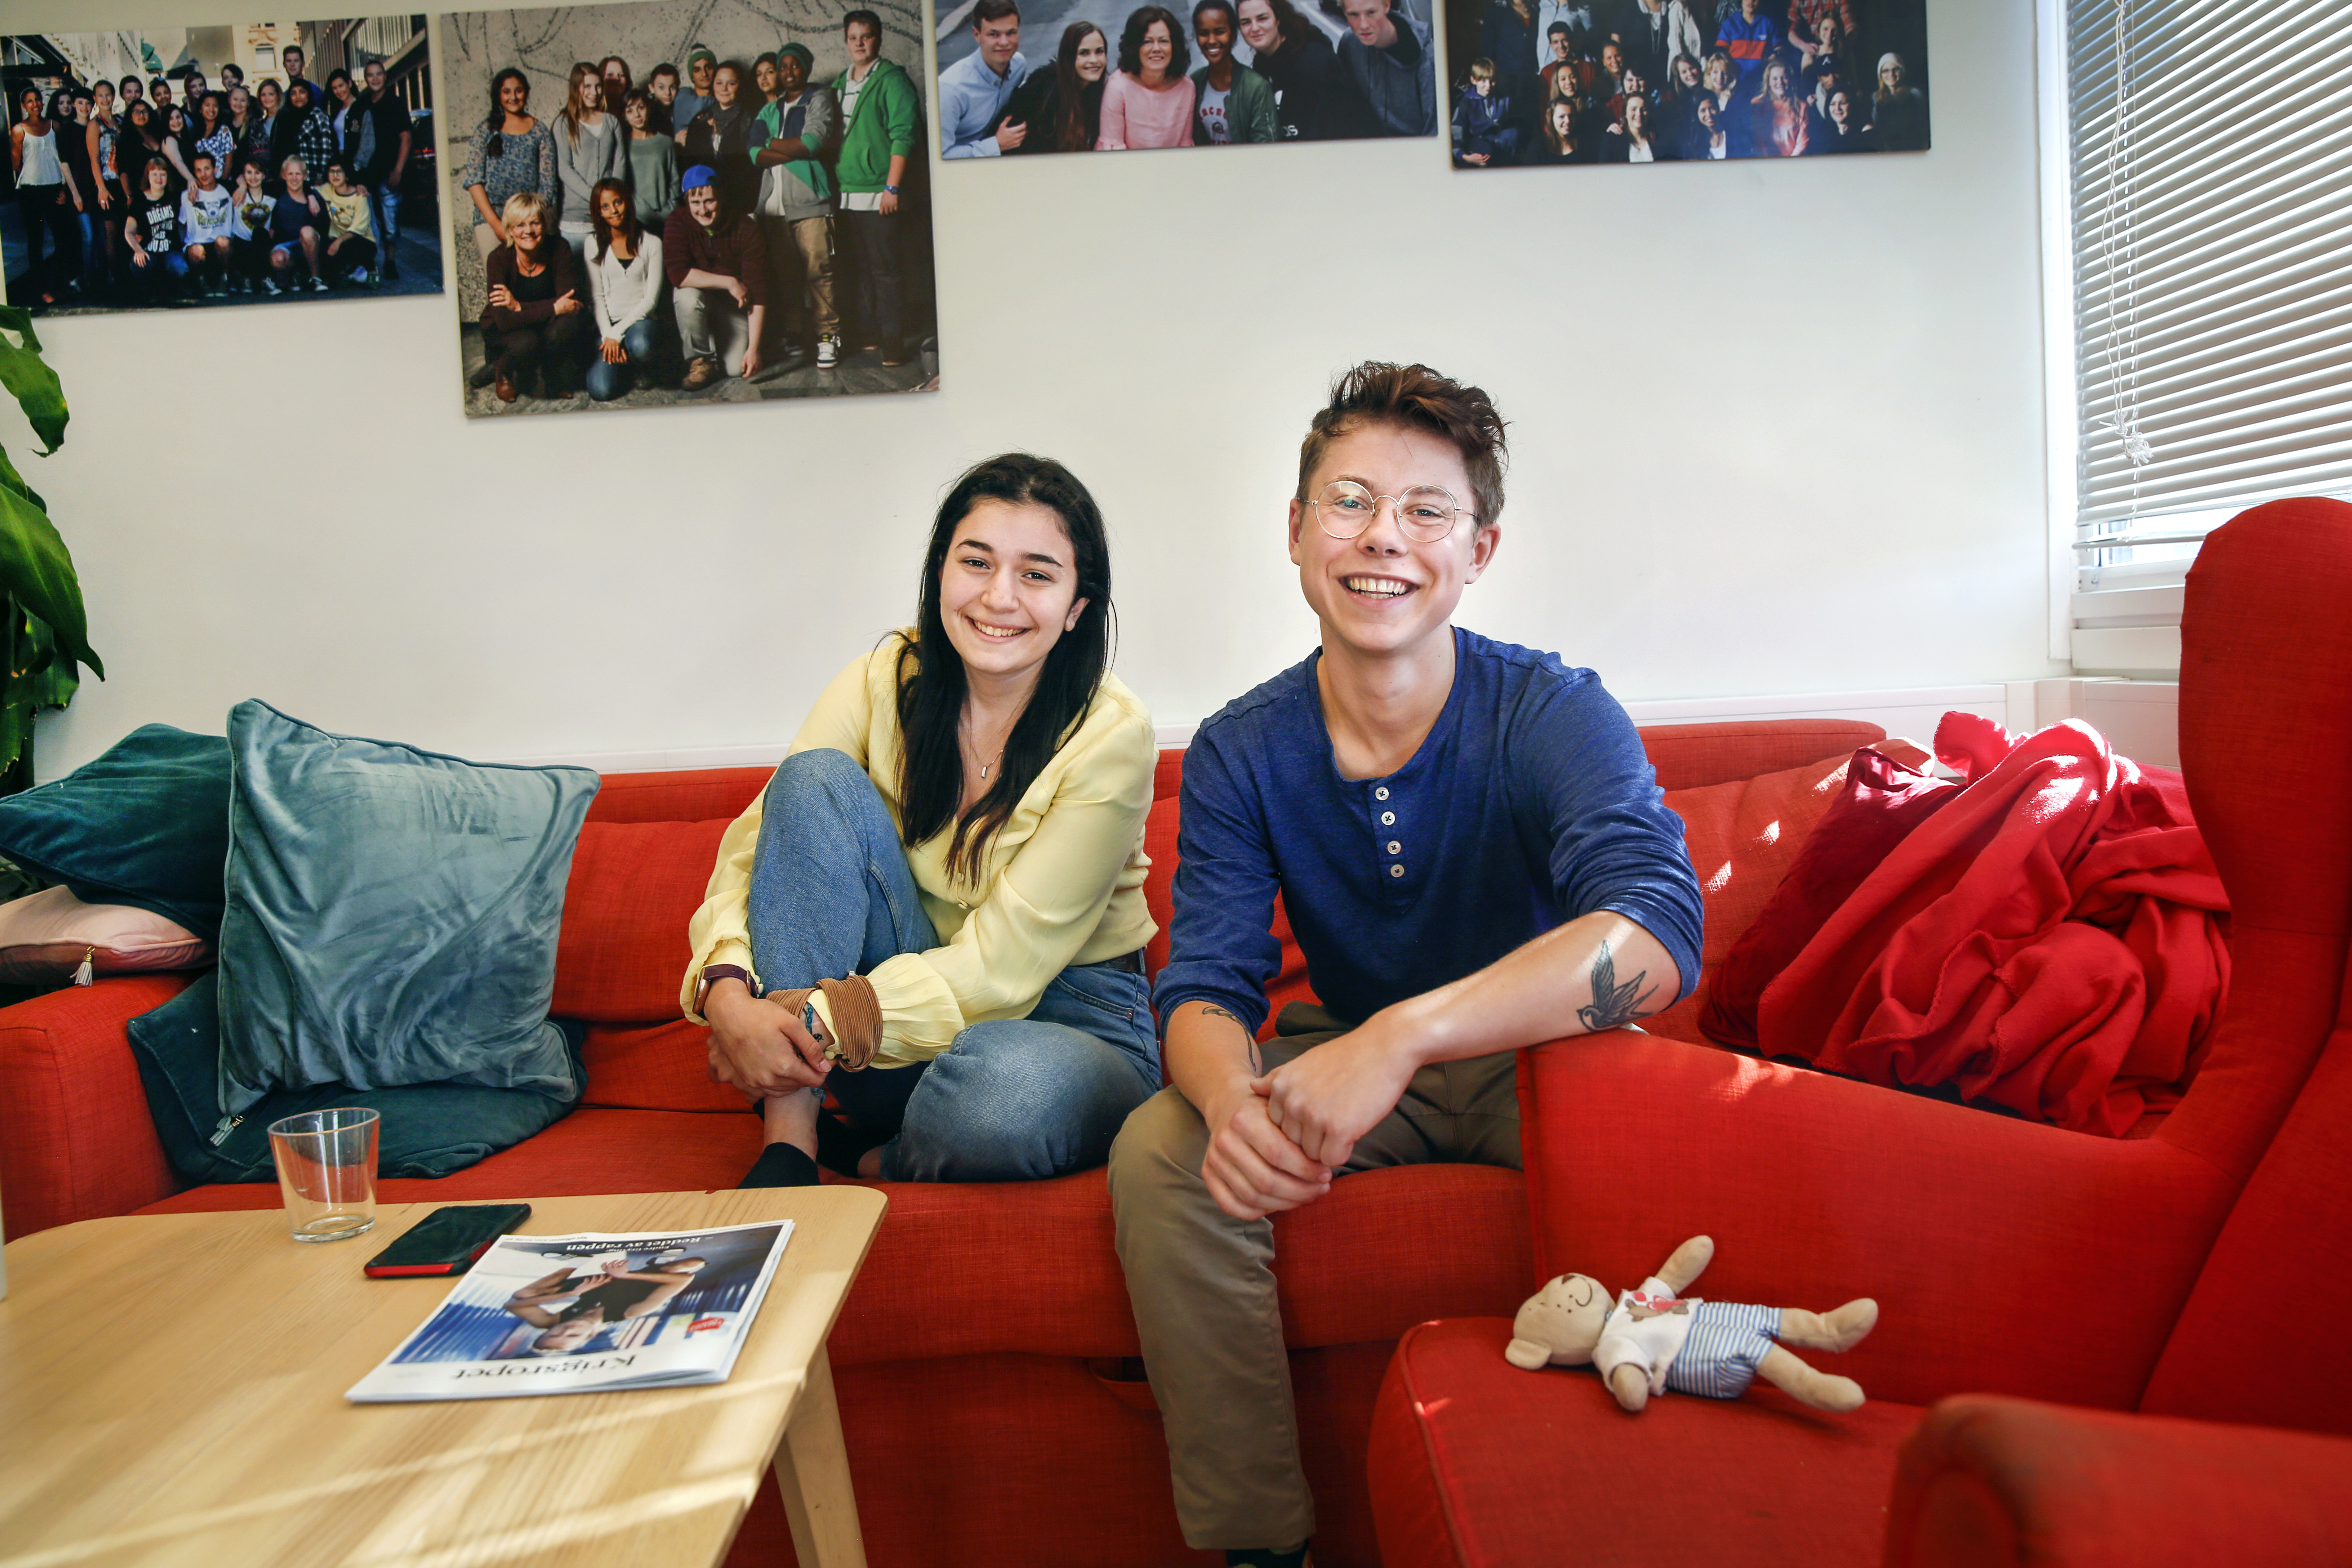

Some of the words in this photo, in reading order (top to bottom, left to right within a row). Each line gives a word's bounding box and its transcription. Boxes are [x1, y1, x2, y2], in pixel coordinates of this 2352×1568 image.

[146, 205, 174, 225] DREAMS
[646, 1237, 701, 1247] Reddet
[450, 1354, 637, 1379] Krigsropet
